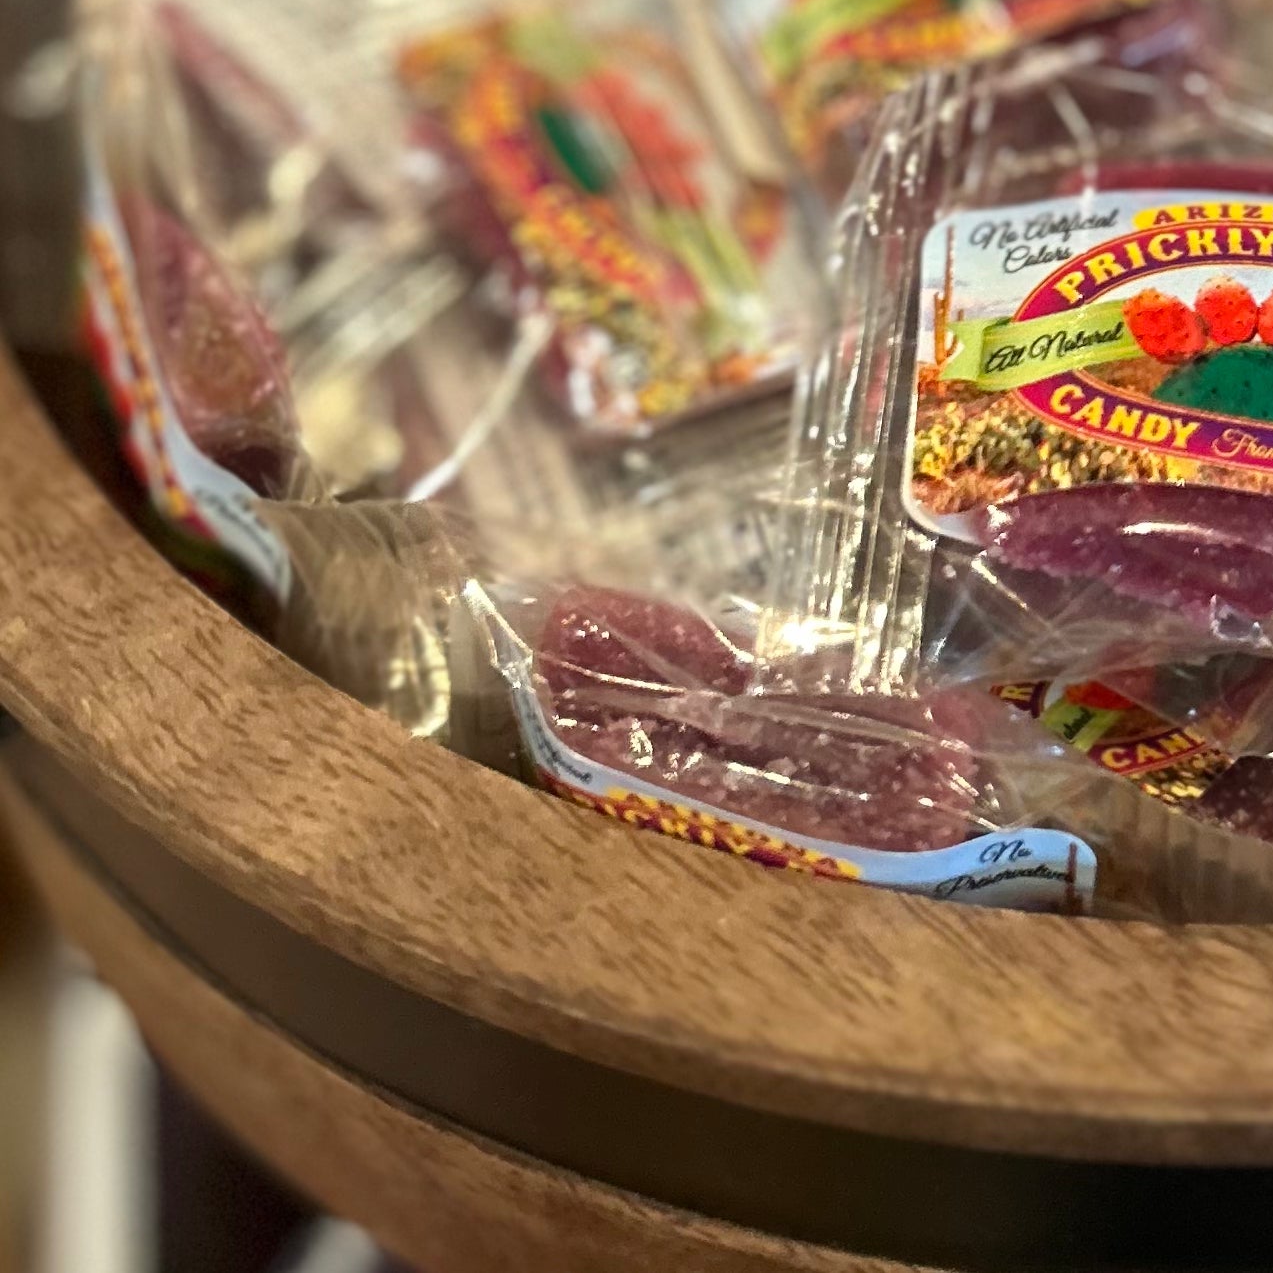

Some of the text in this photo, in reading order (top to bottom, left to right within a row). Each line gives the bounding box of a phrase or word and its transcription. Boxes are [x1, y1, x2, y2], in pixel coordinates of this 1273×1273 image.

[970, 220, 1018, 249] No
[1030, 321, 1125, 361] Natural
[1049, 382, 1201, 452] CANDY
[978, 839, 1033, 864] No
